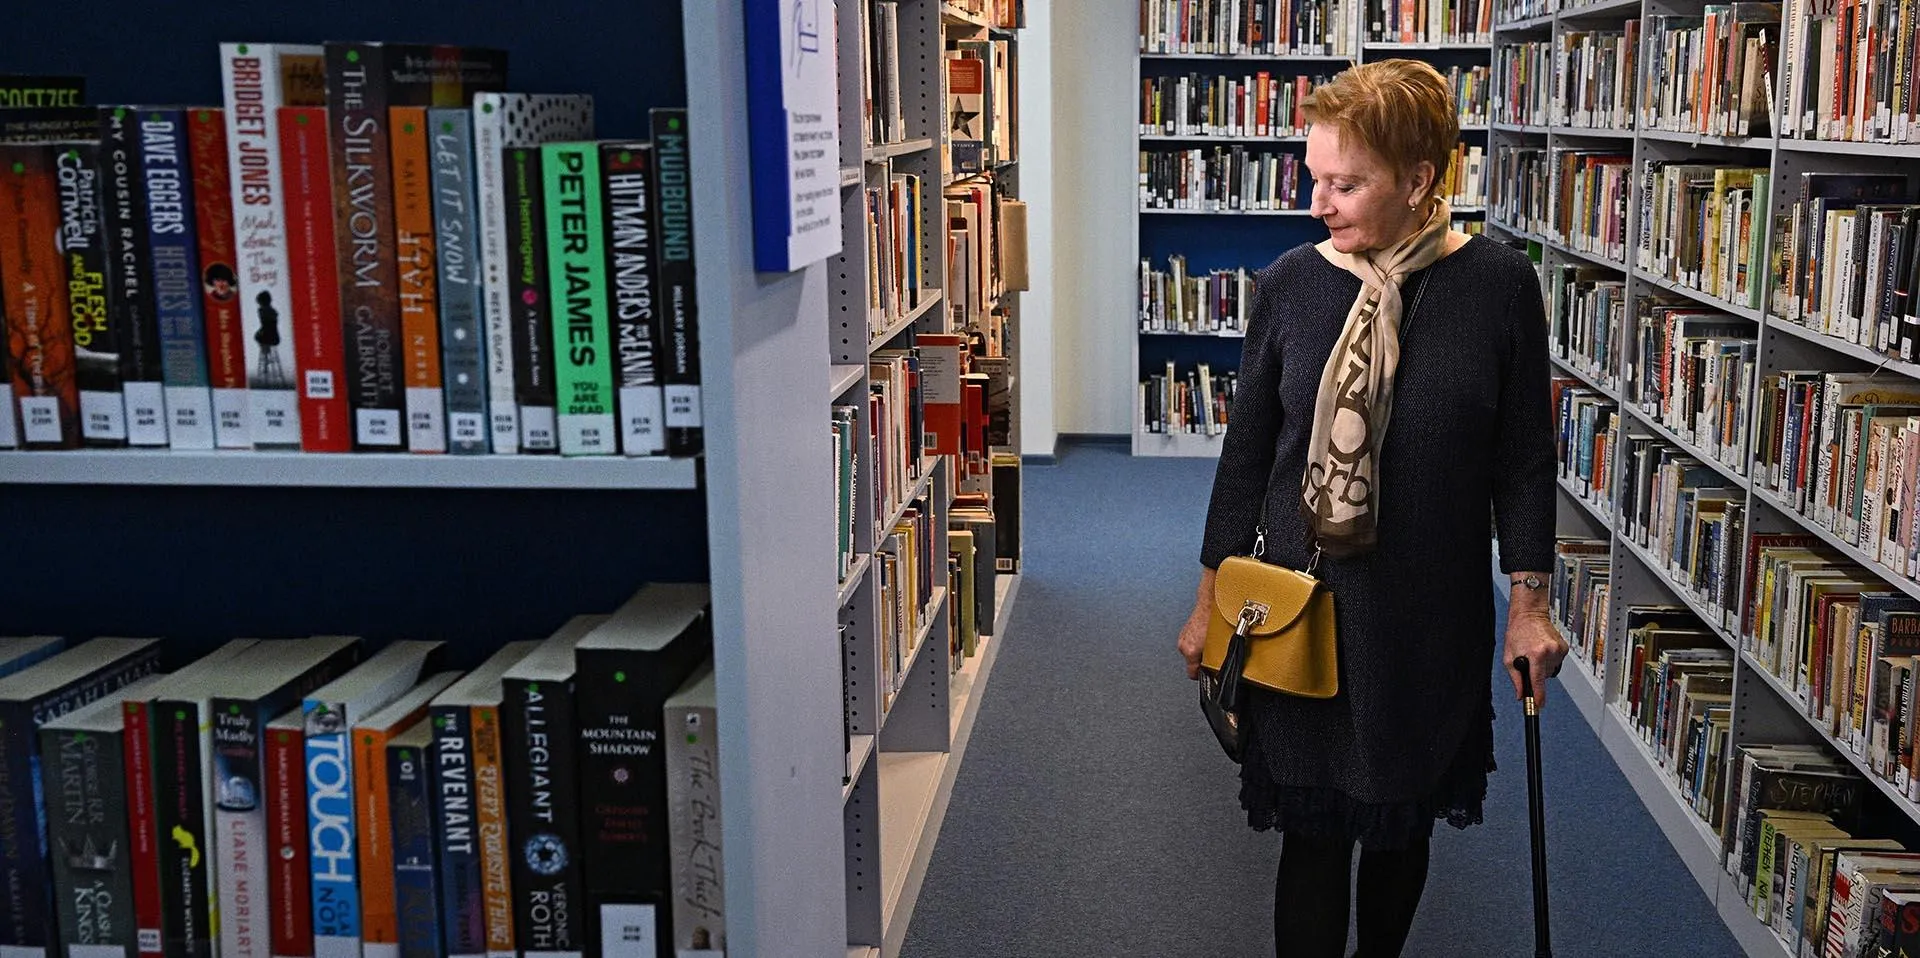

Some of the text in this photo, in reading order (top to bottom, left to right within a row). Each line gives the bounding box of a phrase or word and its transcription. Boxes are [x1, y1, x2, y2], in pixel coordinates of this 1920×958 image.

[232, 57, 272, 205] BRIDGET JONES
[436, 135, 463, 182] LET
[58, 153, 89, 249] Cornwell
[79, 169, 98, 234] Patricia
[113, 150, 132, 219] COUSIN
[141, 120, 186, 233] DAVE EGGERS
[342, 65, 384, 288] THE SILKWORM
[441, 188, 464, 214] IT
[658, 135, 691, 260] MUDBOUND
[121, 227, 138, 298] RACHEL
[441, 218, 469, 284] SNOW
[557, 151, 597, 367] PETER JAMES
[609, 174, 656, 388] HITMAN ANDERS MEANIN
[69, 281, 93, 347] BLOOD
[83, 271, 108, 331] FLESH
[376, 328, 393, 391] ROBERT
[571, 382, 600, 392] YOU
[568, 405, 605, 415] DEAD
[572, 394, 600, 403] ARE
[1783, 415, 1795, 480] SEMI-TOUGH
[1853, 430, 1861, 450] NOW
[1848, 464, 1858, 517] NOVEMBER
[1865, 499, 1874, 517] FROM
[215, 729, 256, 745] Madly
[217, 711, 251, 729] Truly
[445, 713, 457, 731] THE
[581, 728, 657, 741] MOUNTAIN
[589, 743, 651, 756] SHADOW
[60, 736, 87, 824] MARTIN
[526, 690, 553, 823] ALLEGIANT
[307, 733, 353, 881] TOUCH
[440, 737, 473, 853] REVENANT
[477, 765, 500, 817] EVERY
[1774, 775, 1854, 806] STEPHEN
[232, 821, 249, 872] LIANE
[1759, 824, 1775, 900] STEPHEN KIN
[1789, 843, 1802, 891] STEPHEN
[531, 891, 553, 947] ROTH
[551, 882, 570, 949] VERONIC
